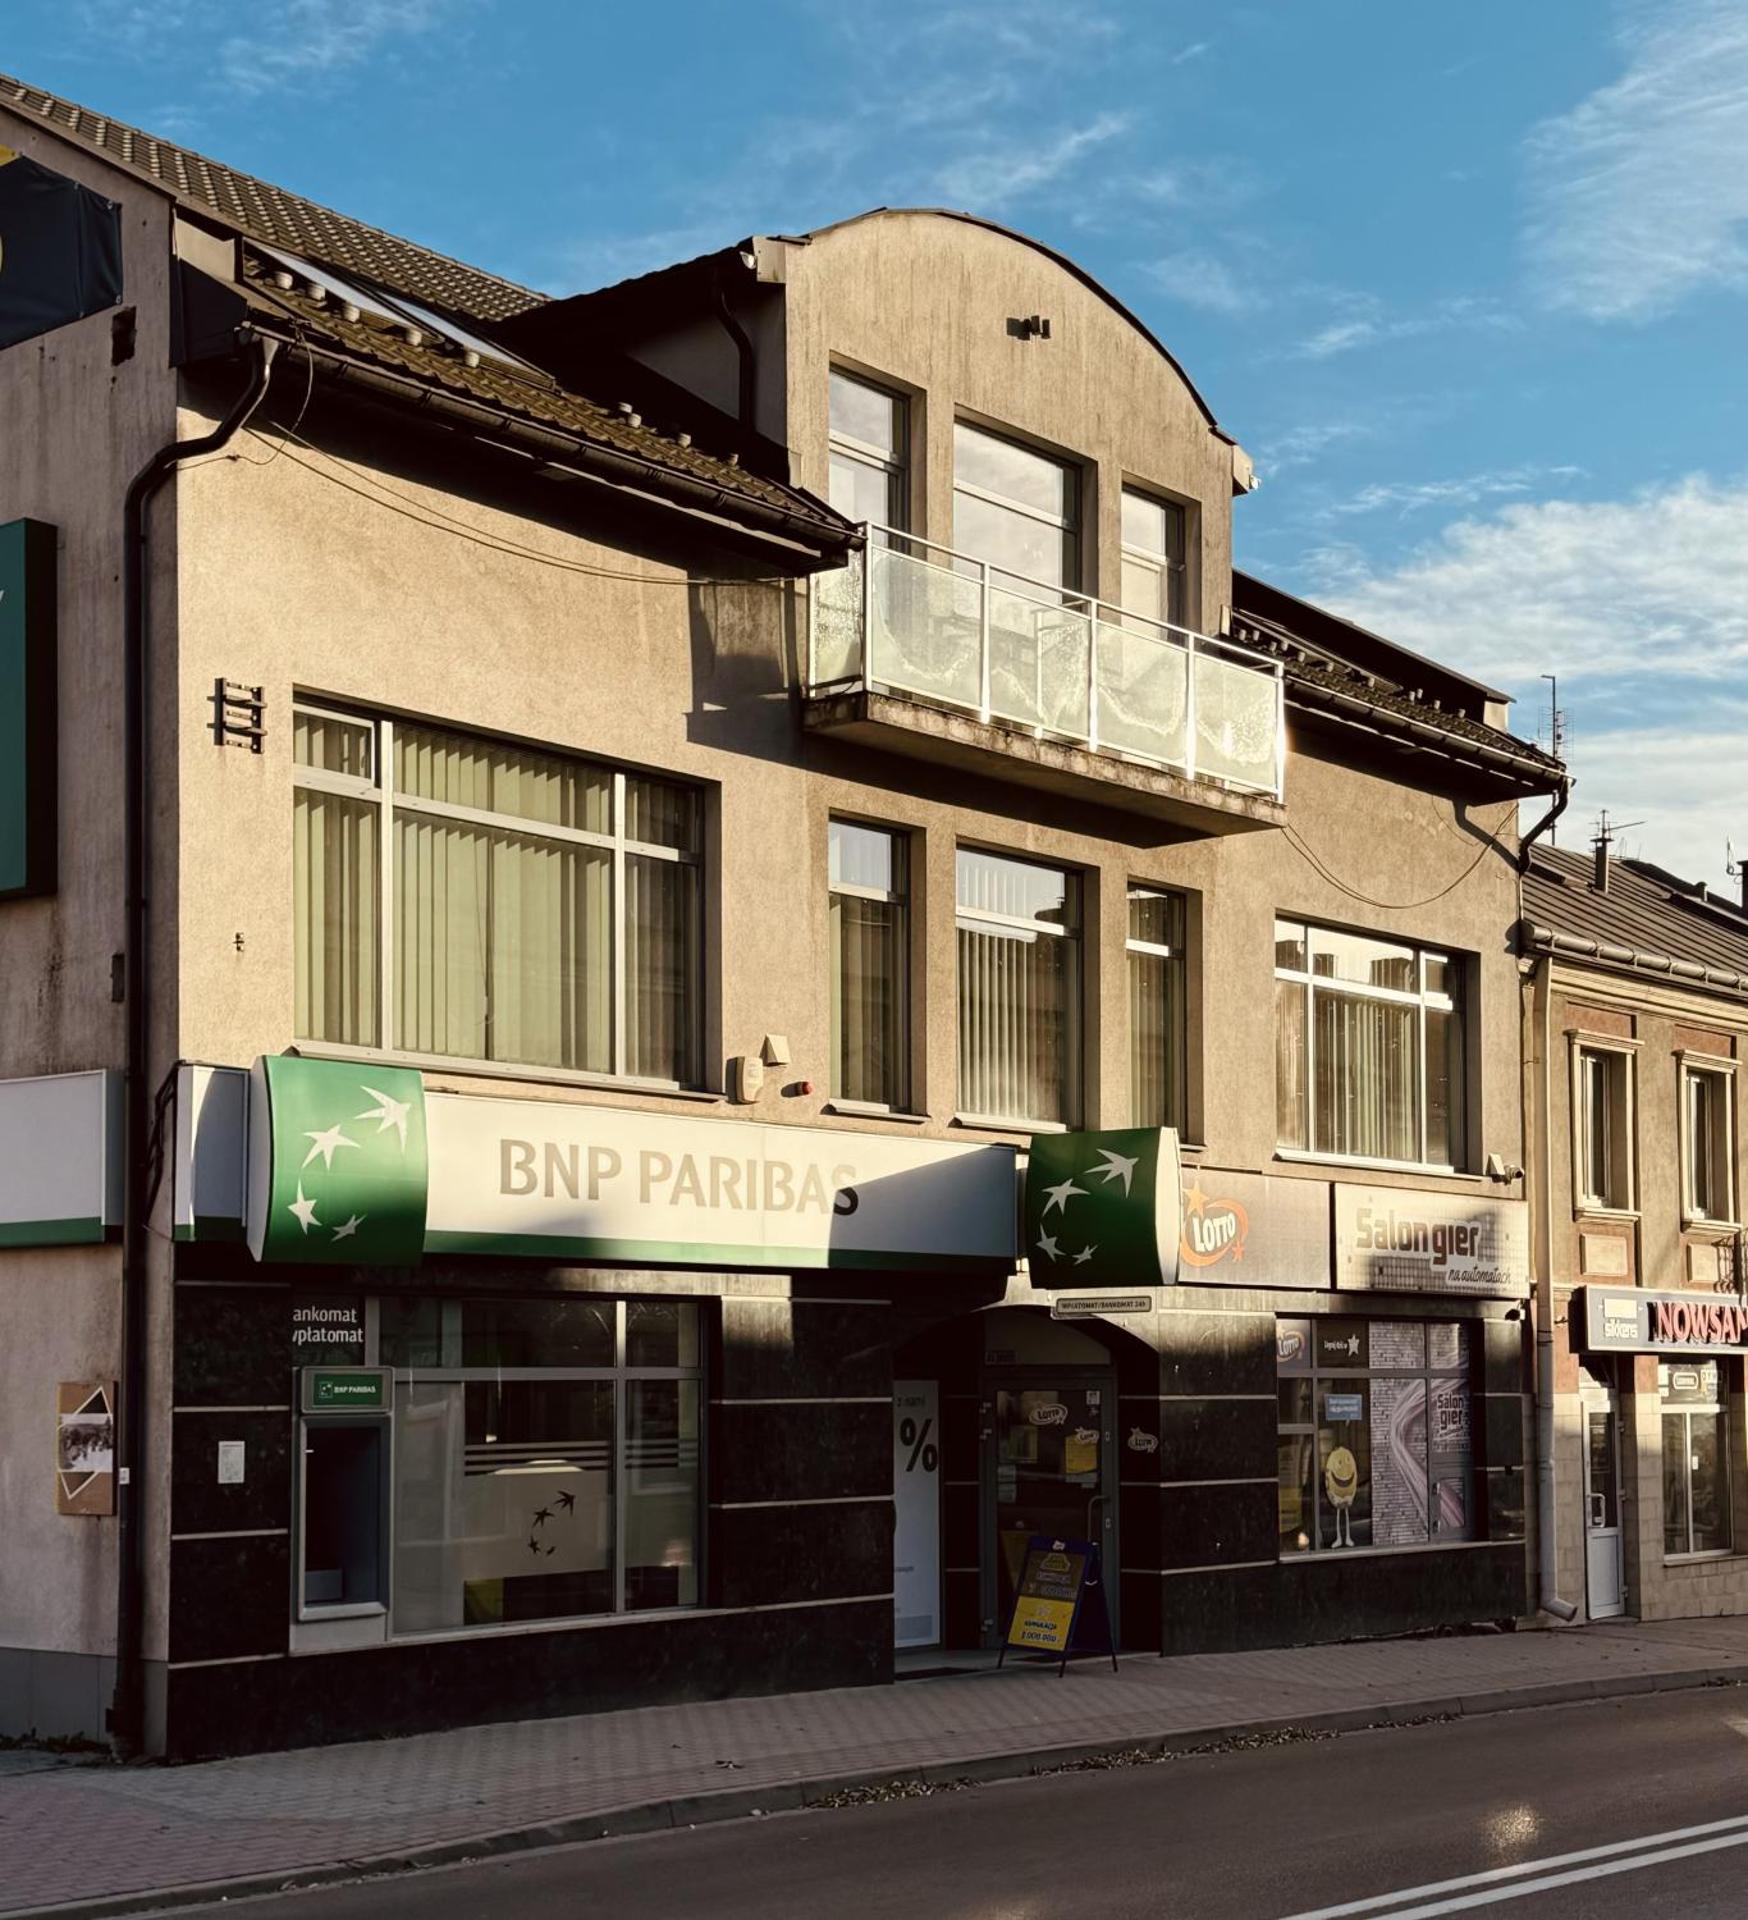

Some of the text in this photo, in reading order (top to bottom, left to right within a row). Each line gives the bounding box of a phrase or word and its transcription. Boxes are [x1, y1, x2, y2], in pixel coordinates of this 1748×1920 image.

[499, 1138, 859, 1216] BNP PARIBAS
[1192, 1212, 1236, 1252] LOTTO
[1356, 1207, 1479, 1265] Salon gier
[1437, 1392, 1465, 1409] Salon
[1440, 1410, 1463, 1431] gier
